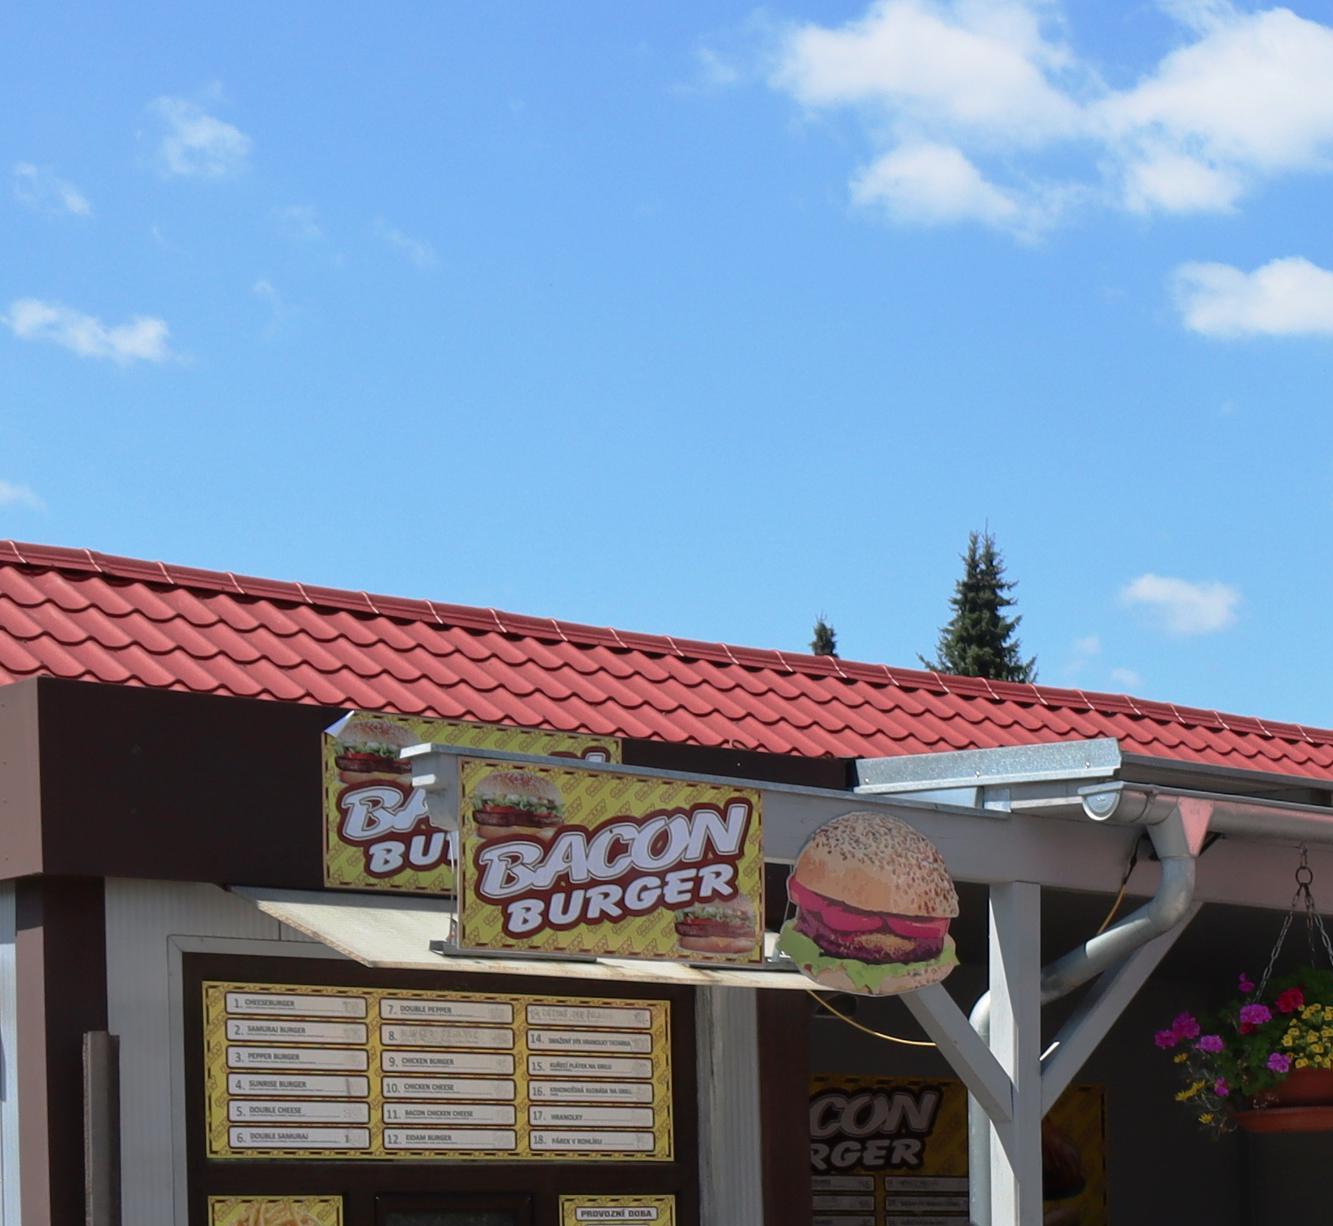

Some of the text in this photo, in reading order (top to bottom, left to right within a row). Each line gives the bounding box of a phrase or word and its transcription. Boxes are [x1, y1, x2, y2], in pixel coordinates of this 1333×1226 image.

[479, 803, 749, 898] BACON
[507, 865, 734, 933] BURGER
[245, 999, 295, 1007] CHEESEBURGER
[400, 1005, 426, 1013] DOUBLE
[249, 1106, 276, 1114] DOUBLE
[809, 1090, 940, 1138] CON
[811, 1138, 923, 1170] RGER
[581, 1209, 625, 1217] PROVOZNÍ
